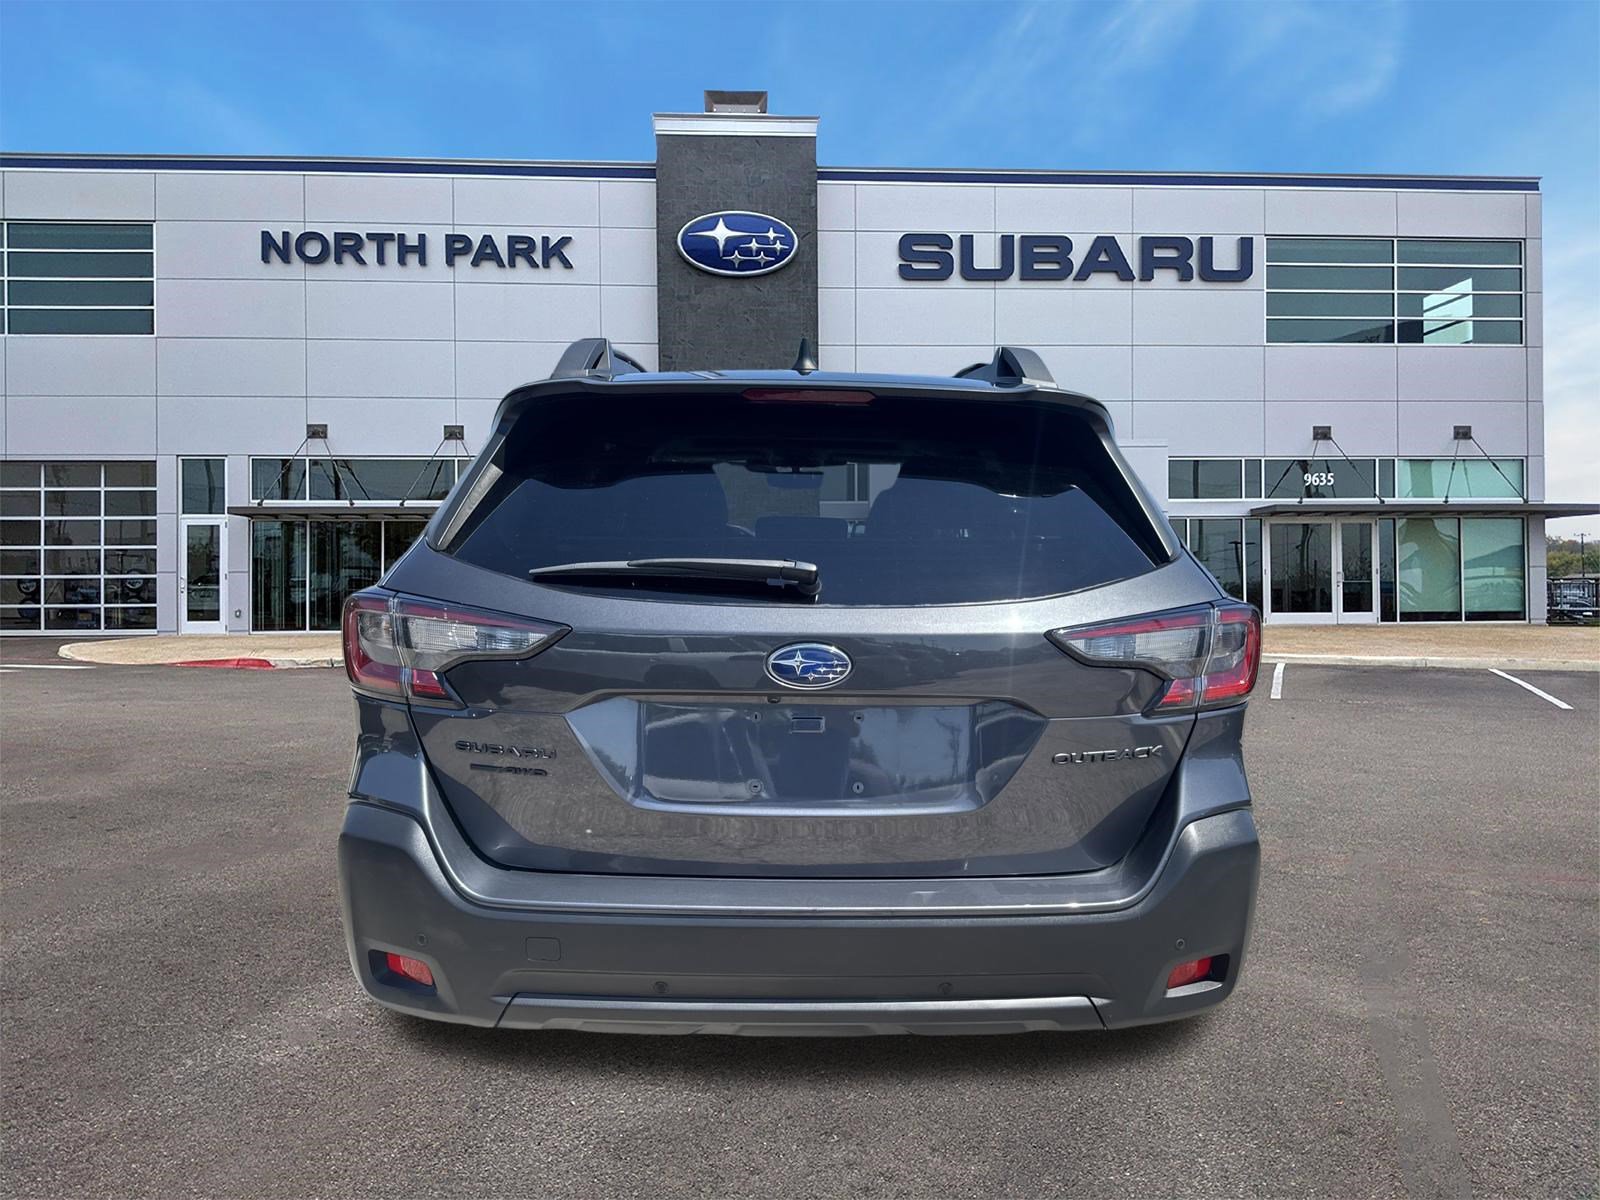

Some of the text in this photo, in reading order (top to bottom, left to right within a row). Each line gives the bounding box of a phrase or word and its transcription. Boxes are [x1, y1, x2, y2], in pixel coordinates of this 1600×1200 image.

[260, 230, 573, 269] NORTH PARK
[898, 233, 1254, 282] SUBARU
[1303, 472, 1335, 486] 9635
[455, 740, 557, 759] SUBARU
[1051, 744, 1163, 765] OUTBACK
